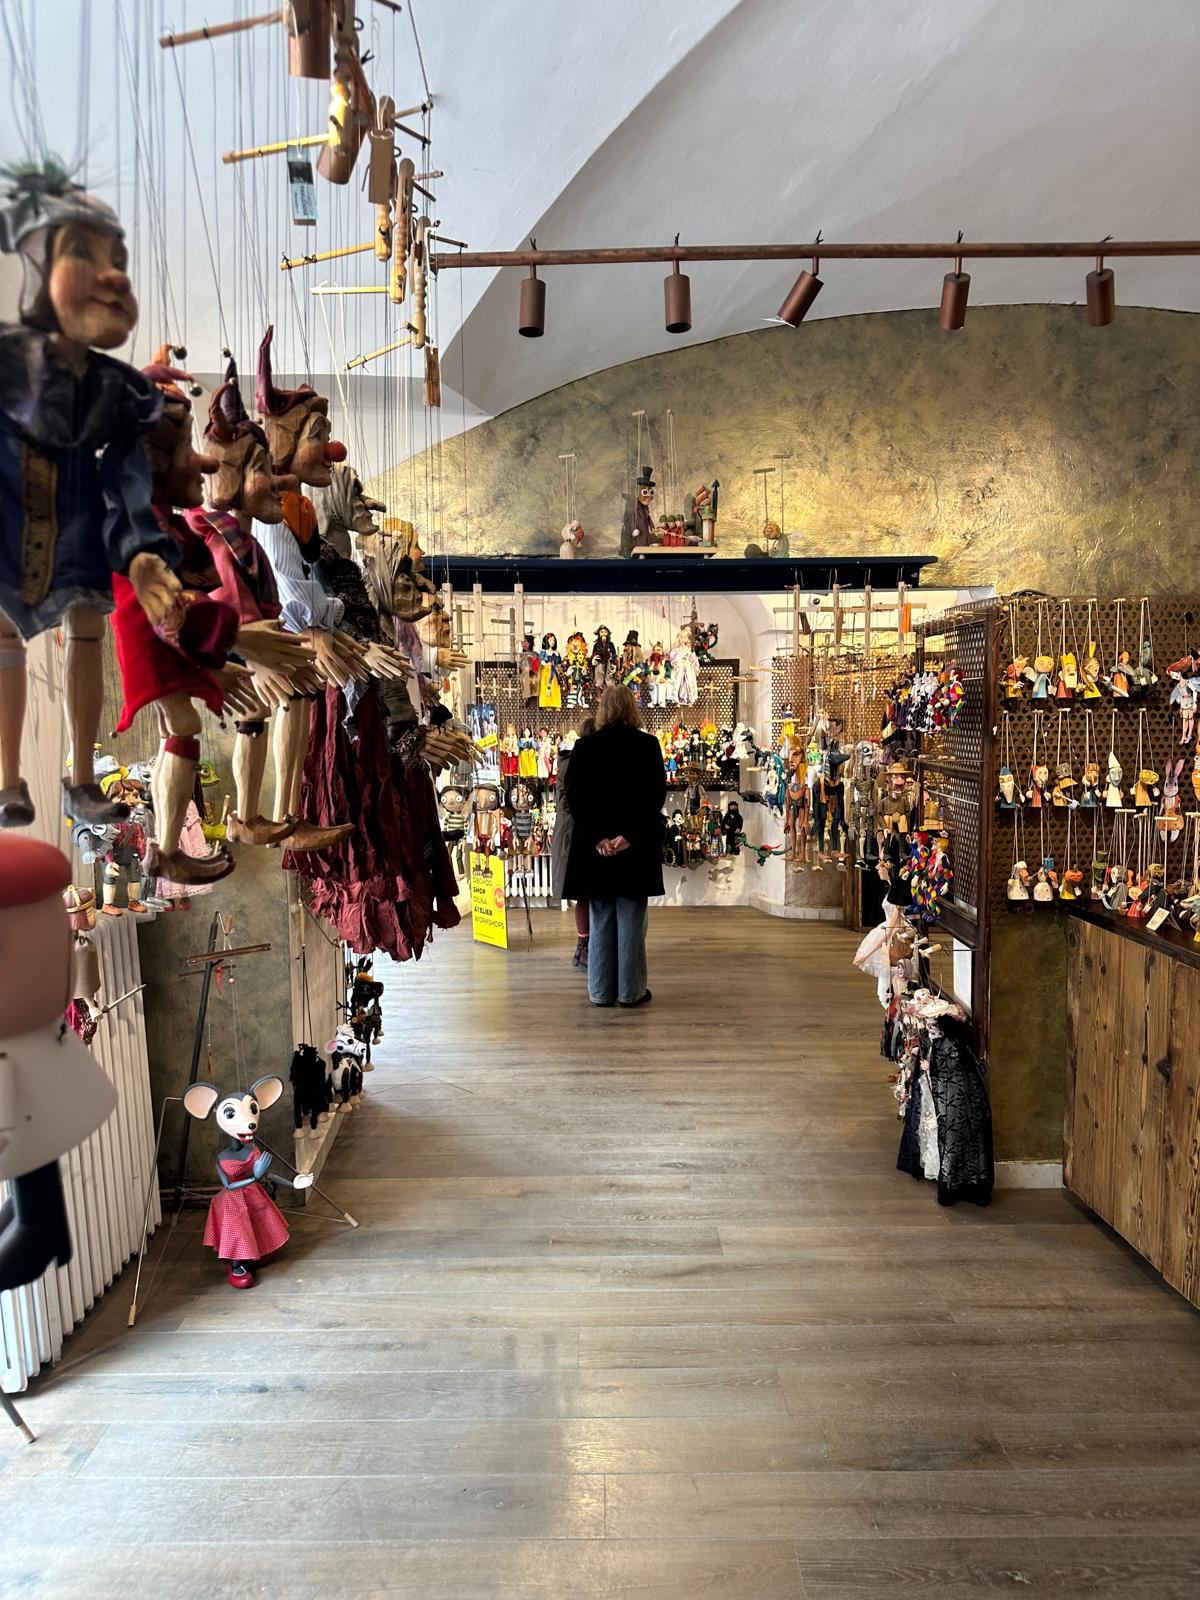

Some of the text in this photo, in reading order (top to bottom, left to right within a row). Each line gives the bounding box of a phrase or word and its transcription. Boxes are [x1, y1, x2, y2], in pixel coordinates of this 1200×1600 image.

[473, 886, 485, 894] SHOP
[474, 906, 492, 916] ATELIER
[475, 916, 504, 929] WORKSHOPS
